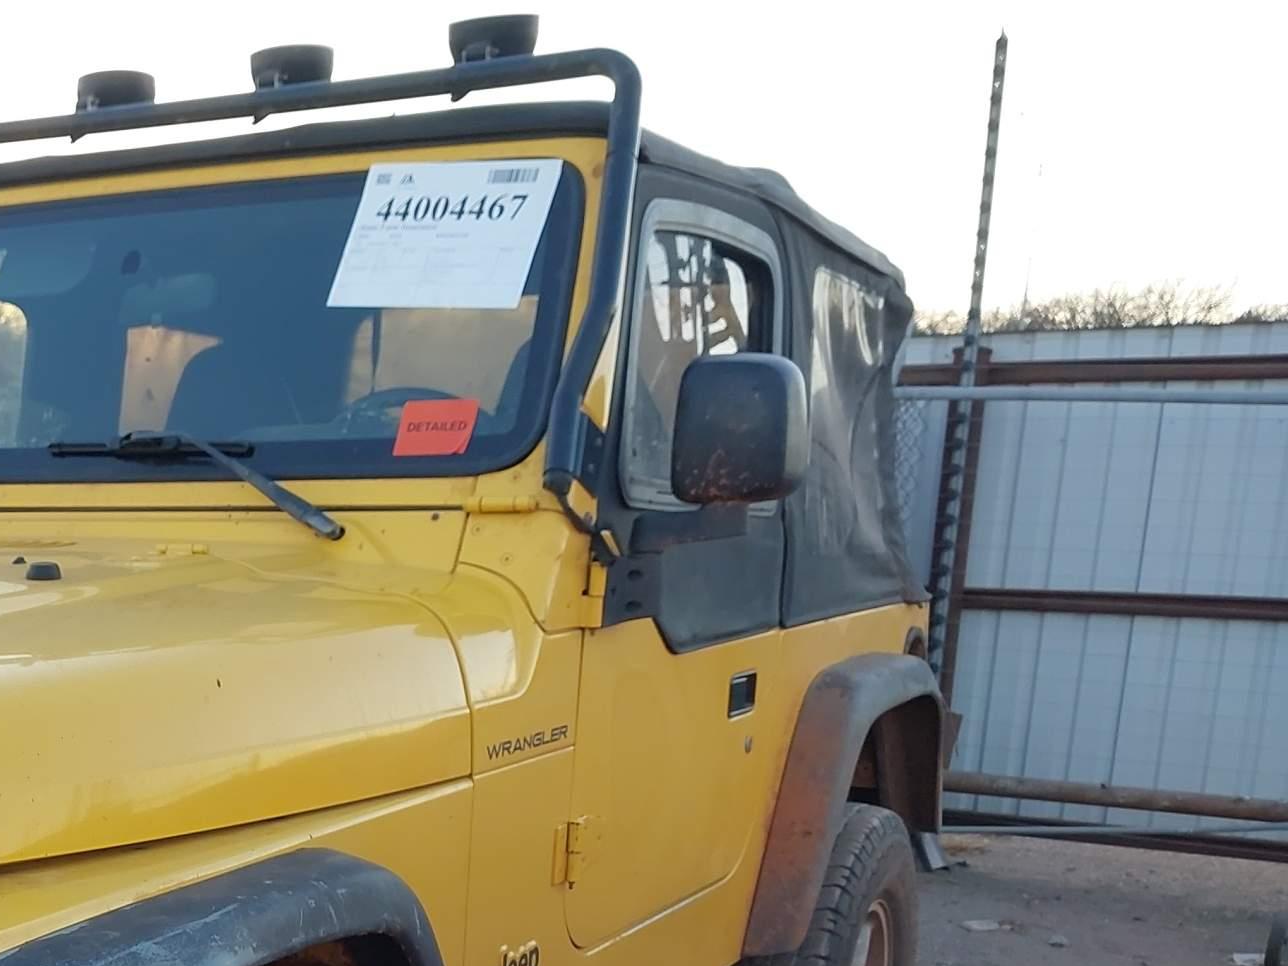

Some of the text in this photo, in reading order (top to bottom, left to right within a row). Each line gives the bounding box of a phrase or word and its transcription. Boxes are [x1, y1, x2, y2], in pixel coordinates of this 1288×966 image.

[376, 193, 529, 222] 44004467
[406, 420, 468, 433] DETAILED
[486, 725, 569, 761] WRANGLER
